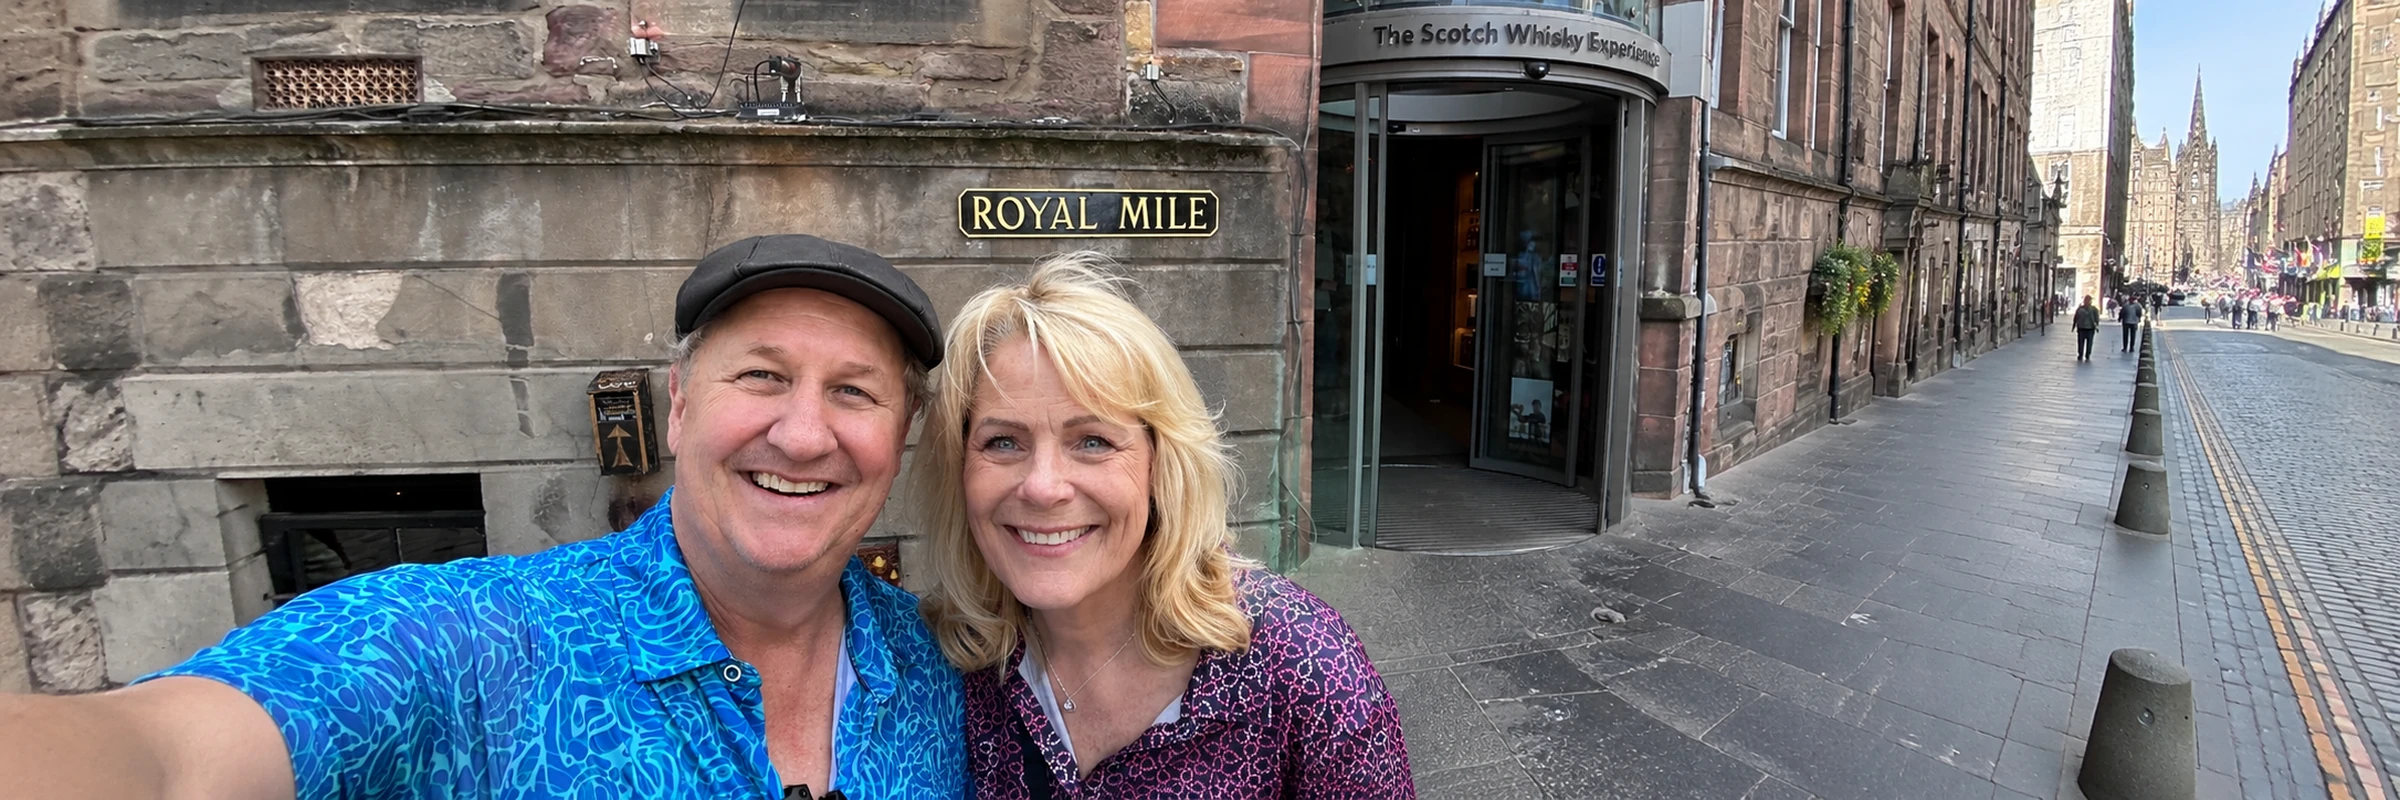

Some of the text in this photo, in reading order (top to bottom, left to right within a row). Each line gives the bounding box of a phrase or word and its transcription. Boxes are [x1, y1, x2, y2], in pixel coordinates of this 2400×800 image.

[1373, 21, 1661, 68] The Scotch Whisky Experience
[972, 196, 1208, 231] ROYAL MILE
